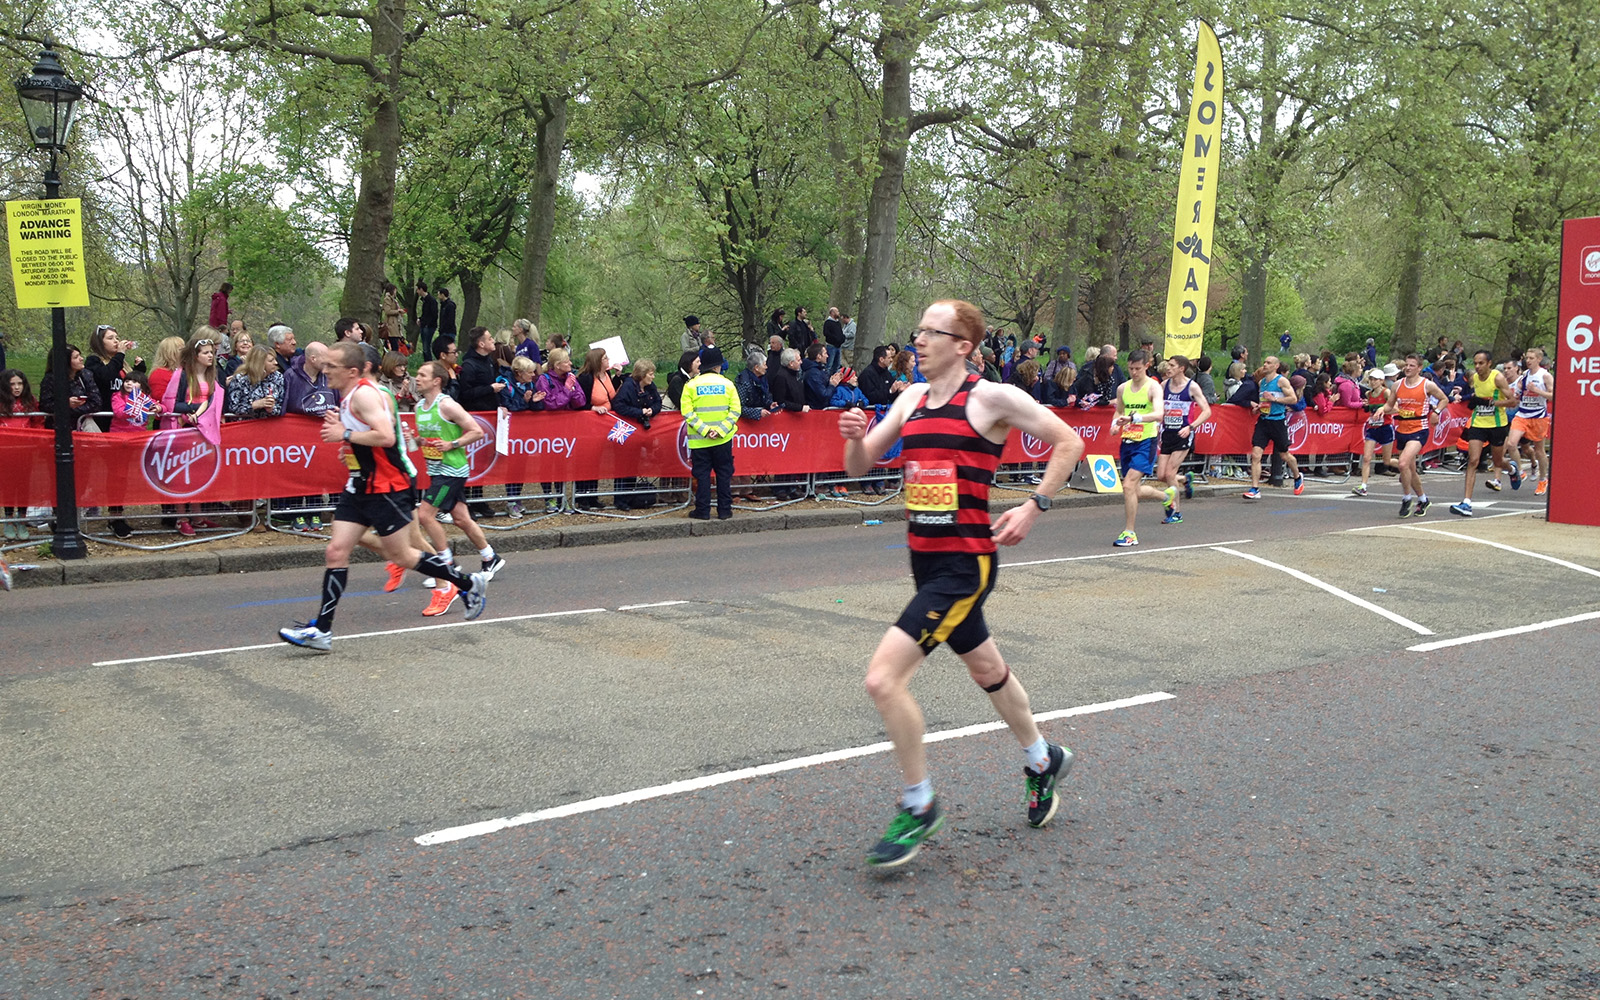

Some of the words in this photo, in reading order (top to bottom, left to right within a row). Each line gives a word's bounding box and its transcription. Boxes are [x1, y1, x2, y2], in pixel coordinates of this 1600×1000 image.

[12, 210, 40, 218] LONDON
[42, 208, 76, 216] MARATHON
[19, 218, 71, 230] ADVANCE
[19, 229, 72, 240] WARNING
[1566, 314, 1600, 352] 6
[697, 385, 724, 395] POLICE
[1072, 425, 1101, 442] oney
[1195, 421, 1217, 437] ney
[1309, 423, 1344, 437] money
[508, 437, 576, 458] money
[731, 433, 790, 452] money
[150, 434, 213, 485] Virgin
[225, 445, 316, 468] money
[921, 468, 954, 478] money
